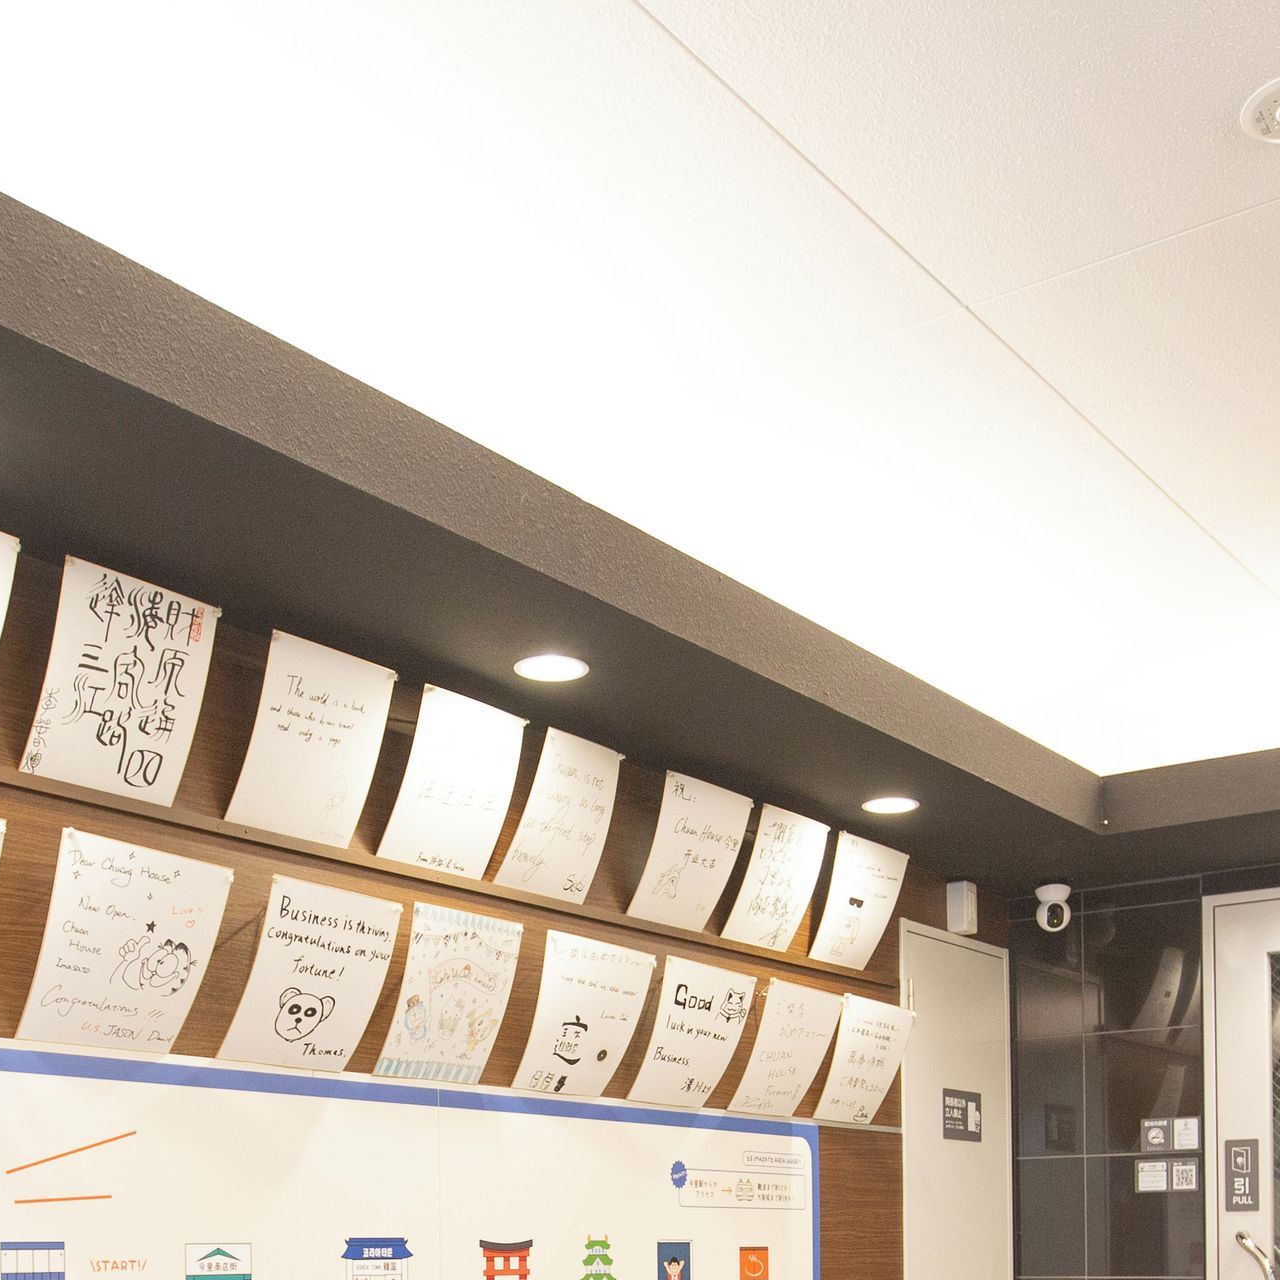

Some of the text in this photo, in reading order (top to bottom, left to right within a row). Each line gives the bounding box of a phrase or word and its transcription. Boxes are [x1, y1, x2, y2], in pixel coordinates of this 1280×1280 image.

[287, 674, 305, 698] The
[140, 866, 172, 884] House
[279, 895, 339, 929] Business
[343, 914, 354, 931] is
[68, 938, 103, 956] House
[267, 926, 352, 955] Congratulations
[354, 948, 367, 957] on
[674, 983, 715, 1013] Good
[1233, 1177, 1250, 1195] 引
[1232, 1196, 1253, 1205] PULL
